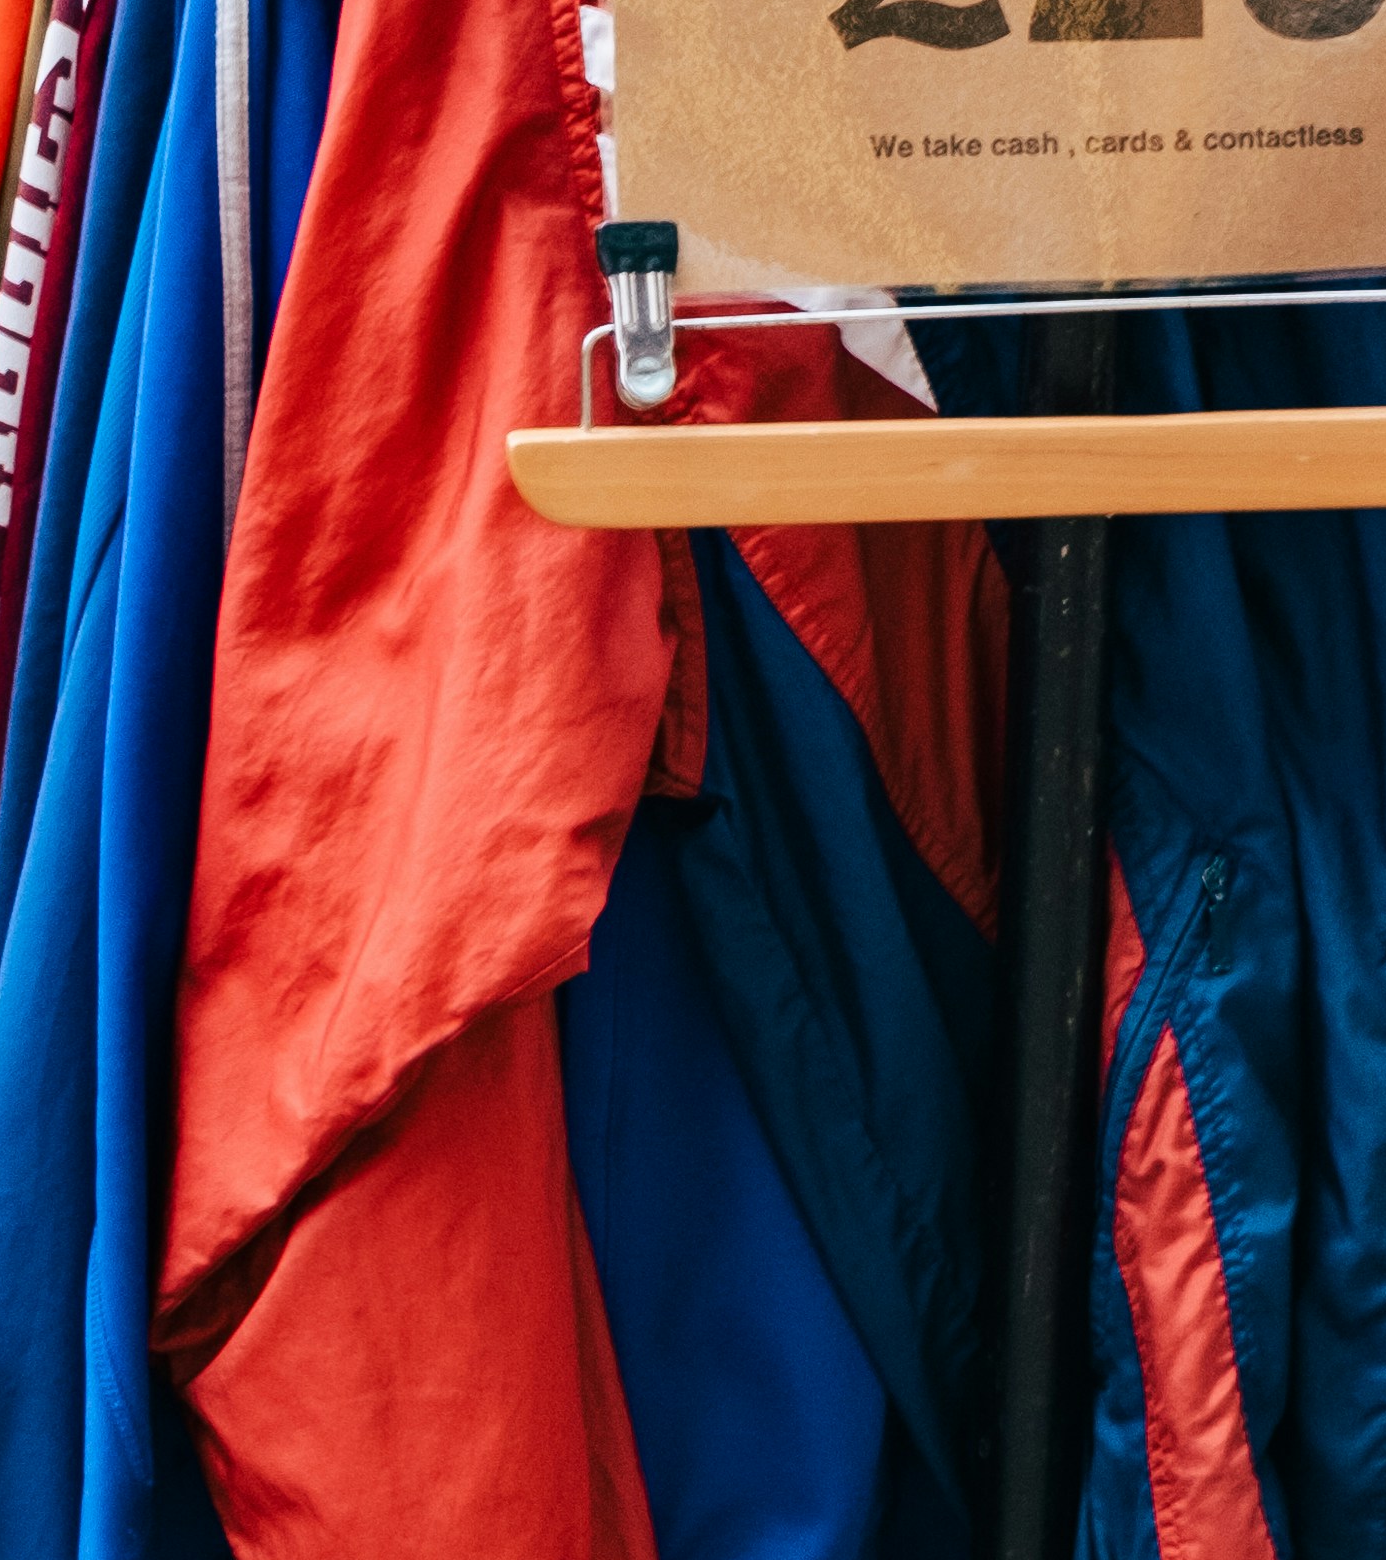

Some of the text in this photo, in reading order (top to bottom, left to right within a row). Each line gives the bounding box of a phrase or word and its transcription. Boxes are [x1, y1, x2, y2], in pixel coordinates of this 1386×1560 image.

[869, 134, 914, 160] We
[922, 132, 984, 159] take
[1085, 129, 1165, 155] cards
[1173, 128, 1194, 153] &
[1202, 124, 1365, 153] contactless
